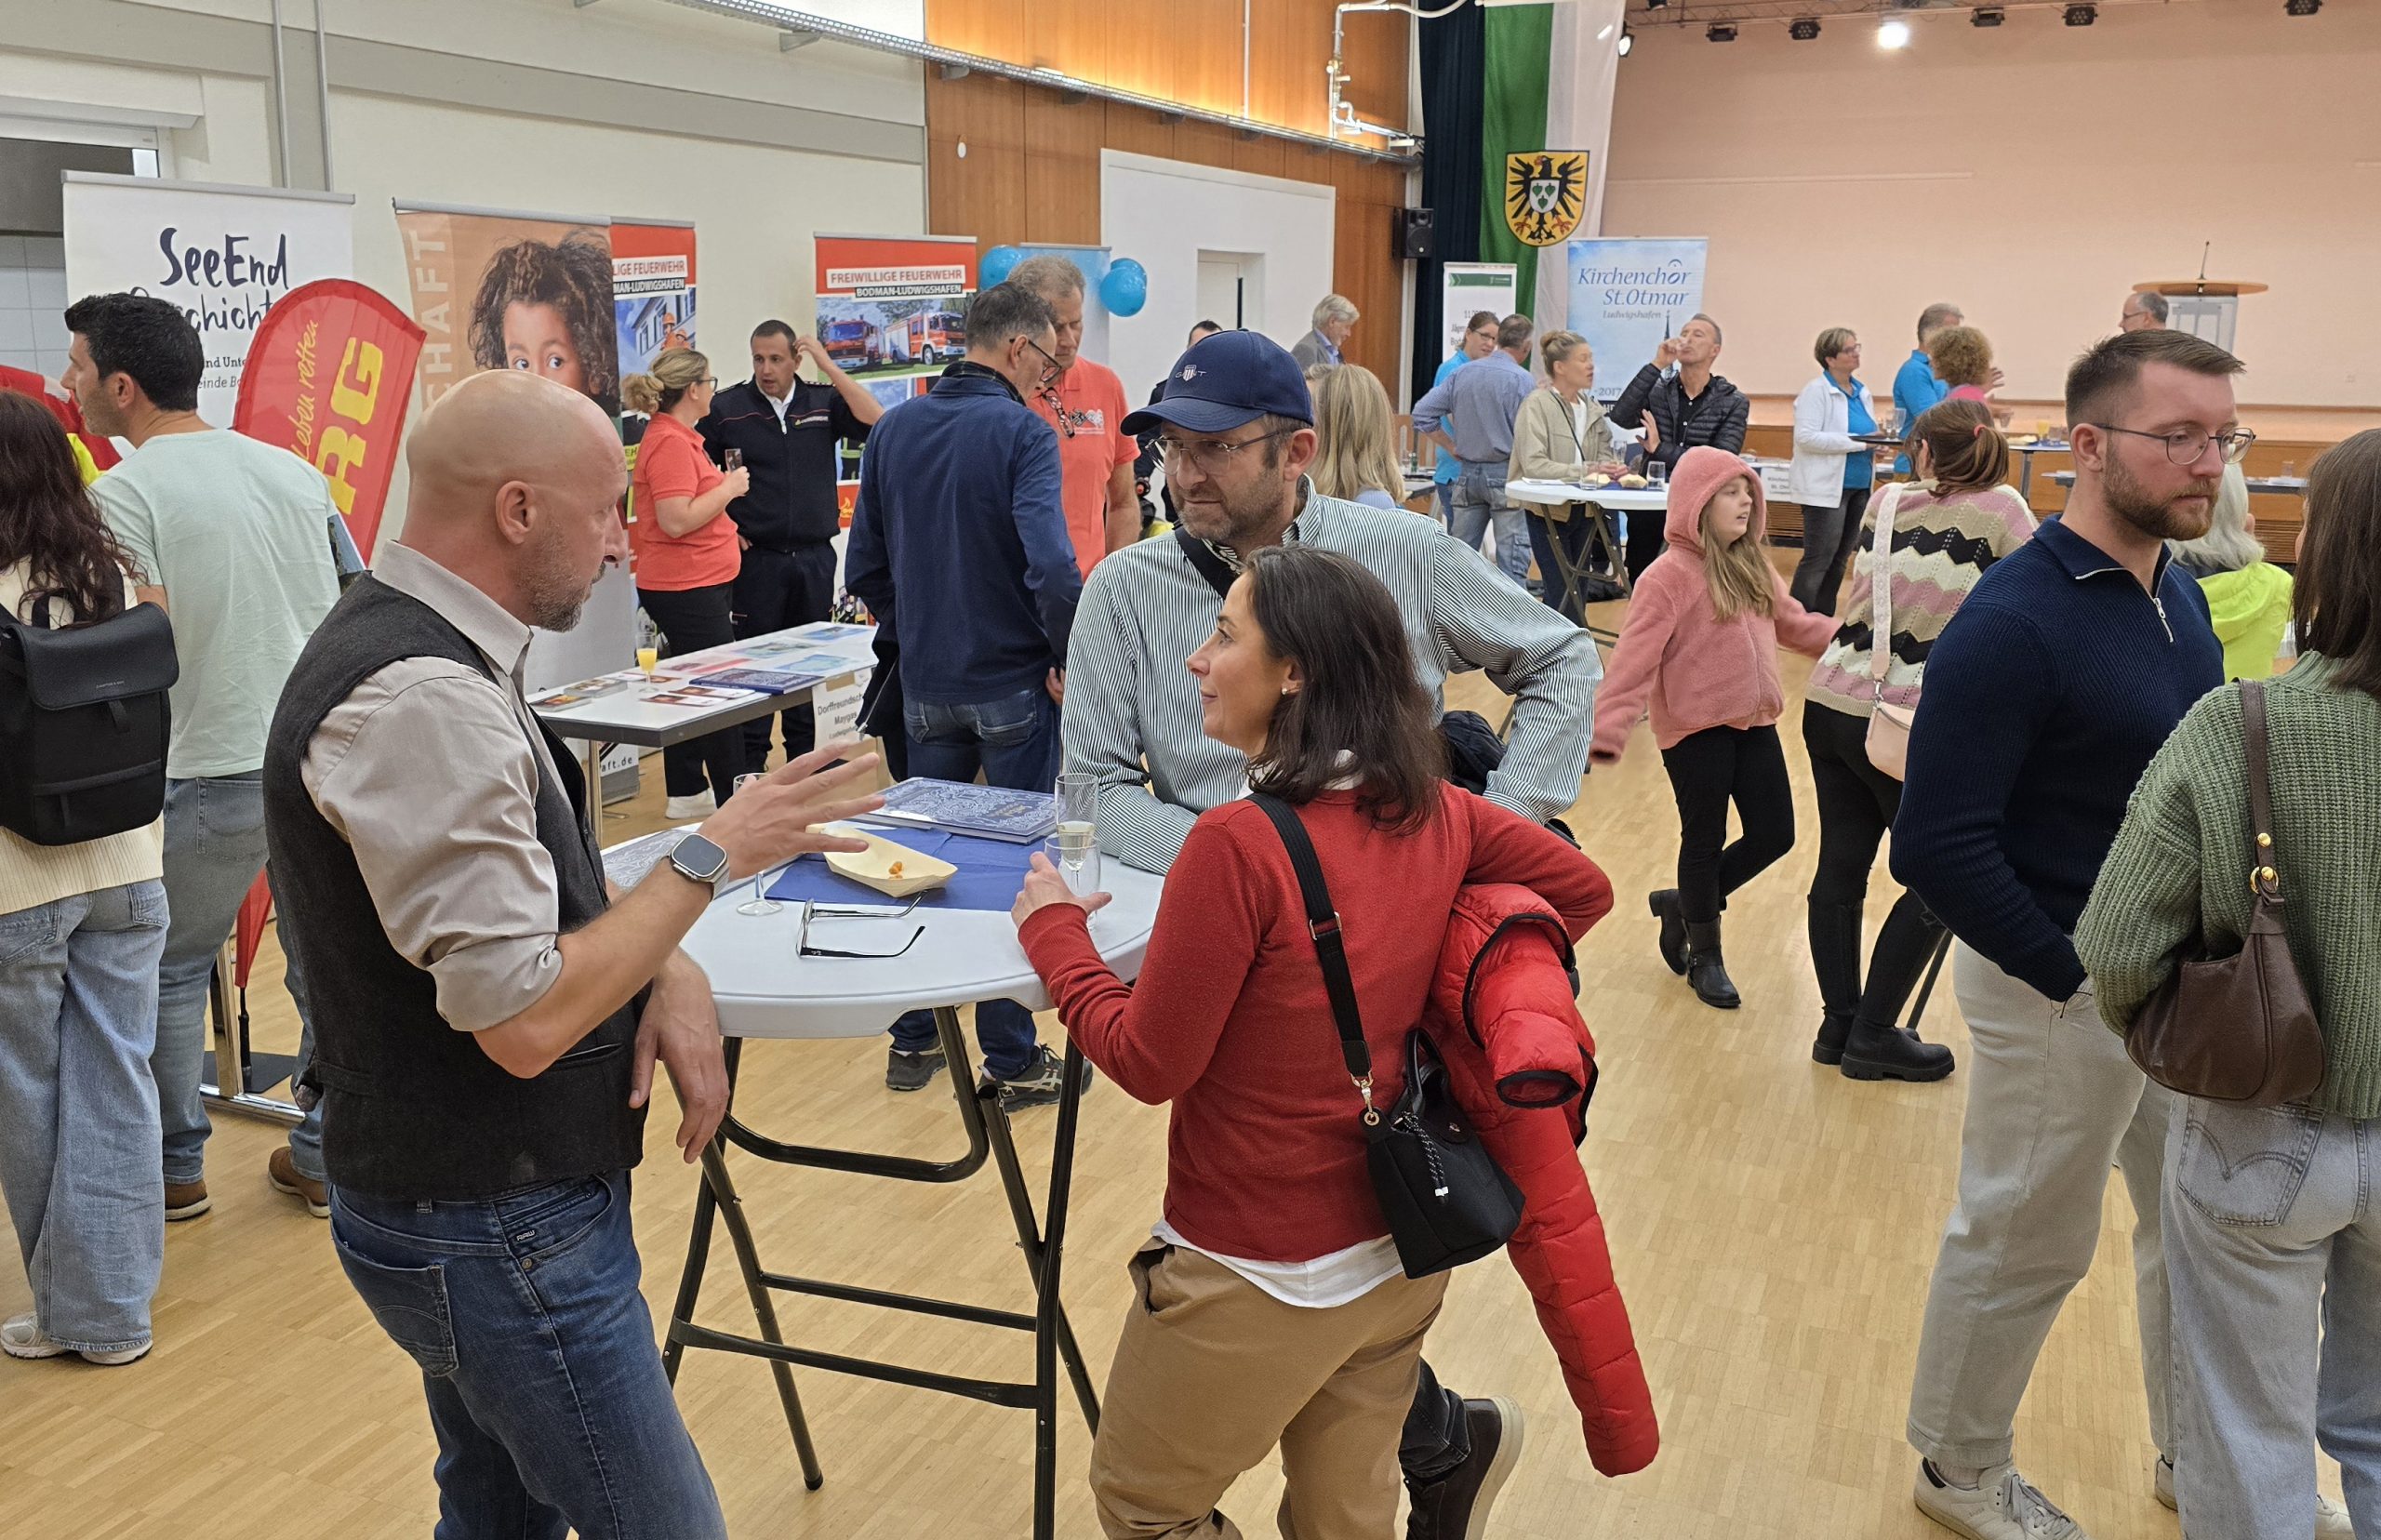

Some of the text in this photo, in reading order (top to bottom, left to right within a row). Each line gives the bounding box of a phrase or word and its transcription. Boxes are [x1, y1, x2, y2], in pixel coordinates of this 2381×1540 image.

[159, 227, 289, 290] SeeEnd
[632, 259, 685, 275] FEUERWEHR
[831, 269, 962, 284] FREIWILLIGE FEUERWEHR
[613, 278, 685, 294] MAN-LUDWIGSHAFEN
[856, 284, 962, 298] BODMAN-LUDWIGSHAFEN
[1603, 310, 1662, 320] Ludwigshafen
[295, 319, 319, 390] retten
